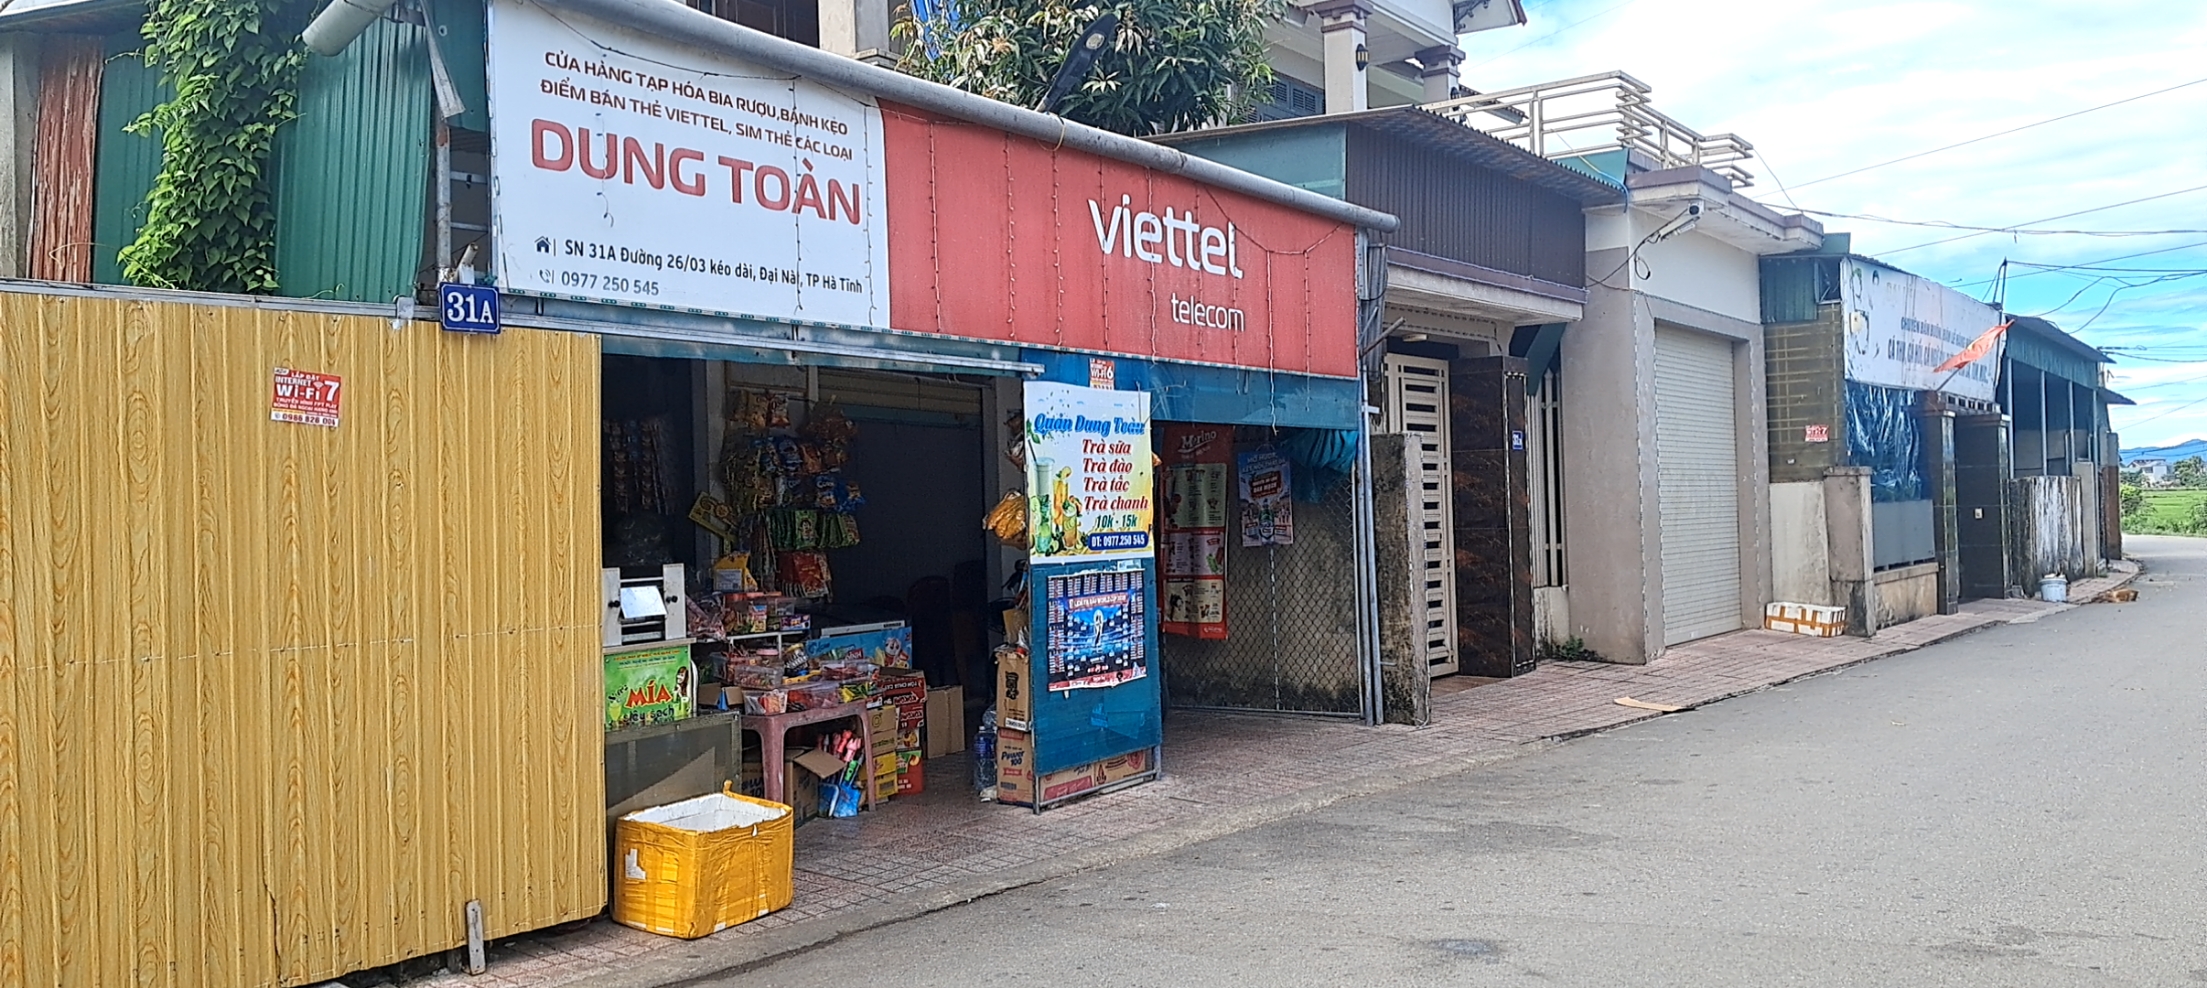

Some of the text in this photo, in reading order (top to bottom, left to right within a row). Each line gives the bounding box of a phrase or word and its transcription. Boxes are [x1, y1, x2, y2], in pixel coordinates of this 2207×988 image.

[545, 50, 580, 72] CỬA
[584, 60, 632, 84] HÀNG
[635, 72, 668, 92] TẠP
[672, 80, 706, 101] HÓA
[708, 90, 733, 108] BIA
[821, 116, 848, 136] KẸO
[540, 76, 853, 162] ĐIỂM BÁN THẺ VIETTEL, SIM THẺ CÁC LOẠI
[531, 118, 862, 226] DUNG TOÀN
[1088, 194, 1244, 280] viettel
[565, 239, 584, 257] SN
[589, 243, 616, 261] 31A
[620, 247, 663, 271] Đường
[667, 253, 706, 273] 26/03
[710, 259, 731, 276] kéo
[735, 262, 756, 282] dài,
[759, 266, 778, 285] Đại
[805, 273, 820, 287] TP
[822, 275, 837, 290] Hà
[839, 277, 863, 293] Tĩnh
[561, 270, 660, 296] 0977 250 545
[447, 291, 494, 323] 31A
[1170, 292, 1245, 332] telecom
[275, 376, 312, 387] INTERNET
[1107, 366, 1114, 379] 6
[276, 380, 340, 402] Wi-Fi 7
[1074, 415, 1111, 437] Dung
[1083, 438, 1131, 454] Trà sữa
[1181, 430, 1217, 449] Merino
[1083, 457, 1132, 473] Trà đào
[1084, 475, 1108, 492] Trà
[1084, 494, 1149, 511] Trà chanh
[1097, 514, 1114, 528] 10k
[1122, 514, 1138, 527] 15k
[624, 680, 672, 709] MÍA
